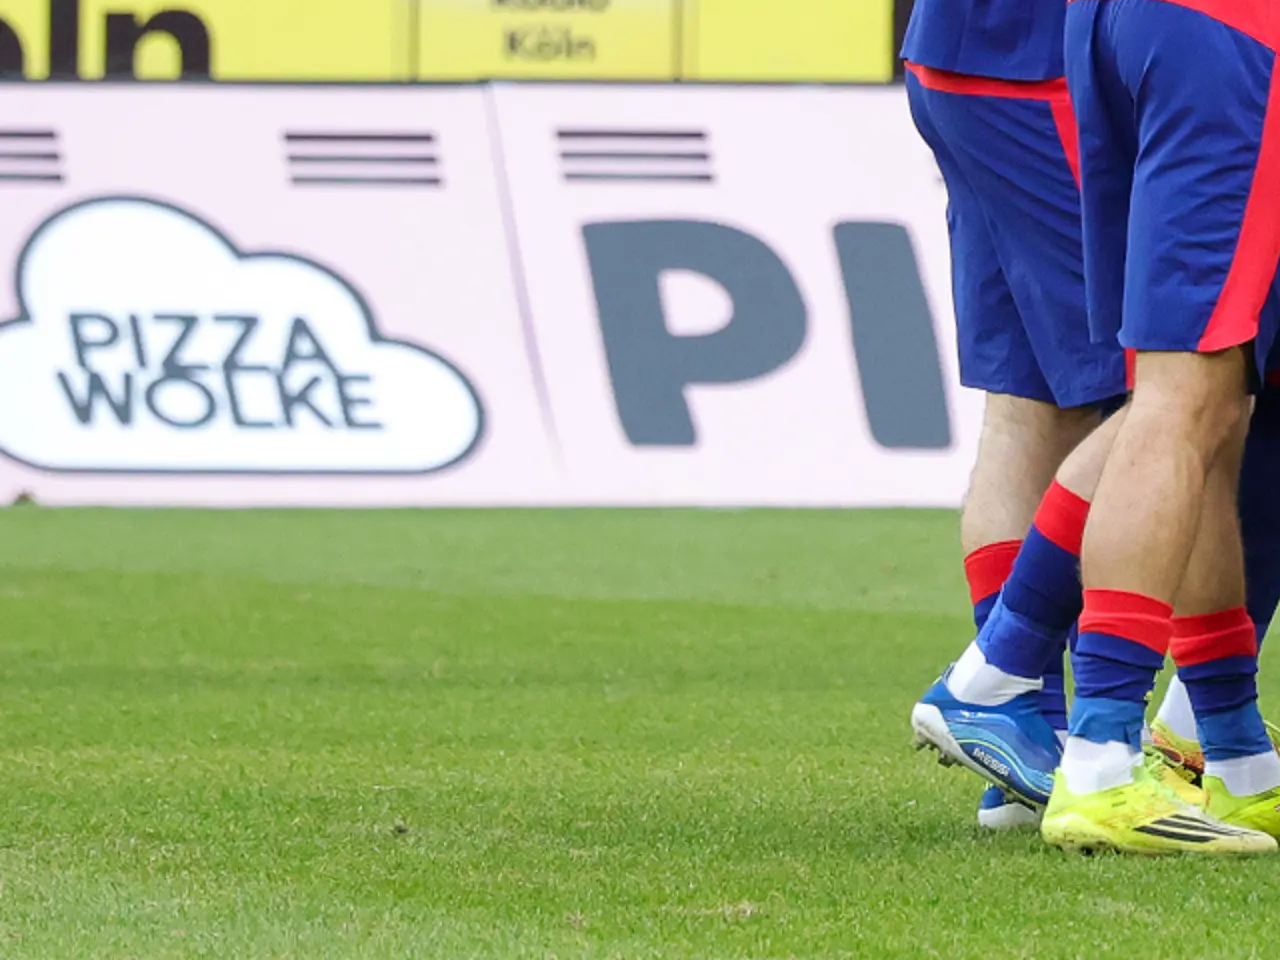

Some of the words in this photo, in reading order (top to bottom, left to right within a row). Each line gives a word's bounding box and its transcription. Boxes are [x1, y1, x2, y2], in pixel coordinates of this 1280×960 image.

[507, 26, 597, 59] Köln
[68, 314, 342, 374] PIZZA
[56, 369, 384, 428] WOLKE
